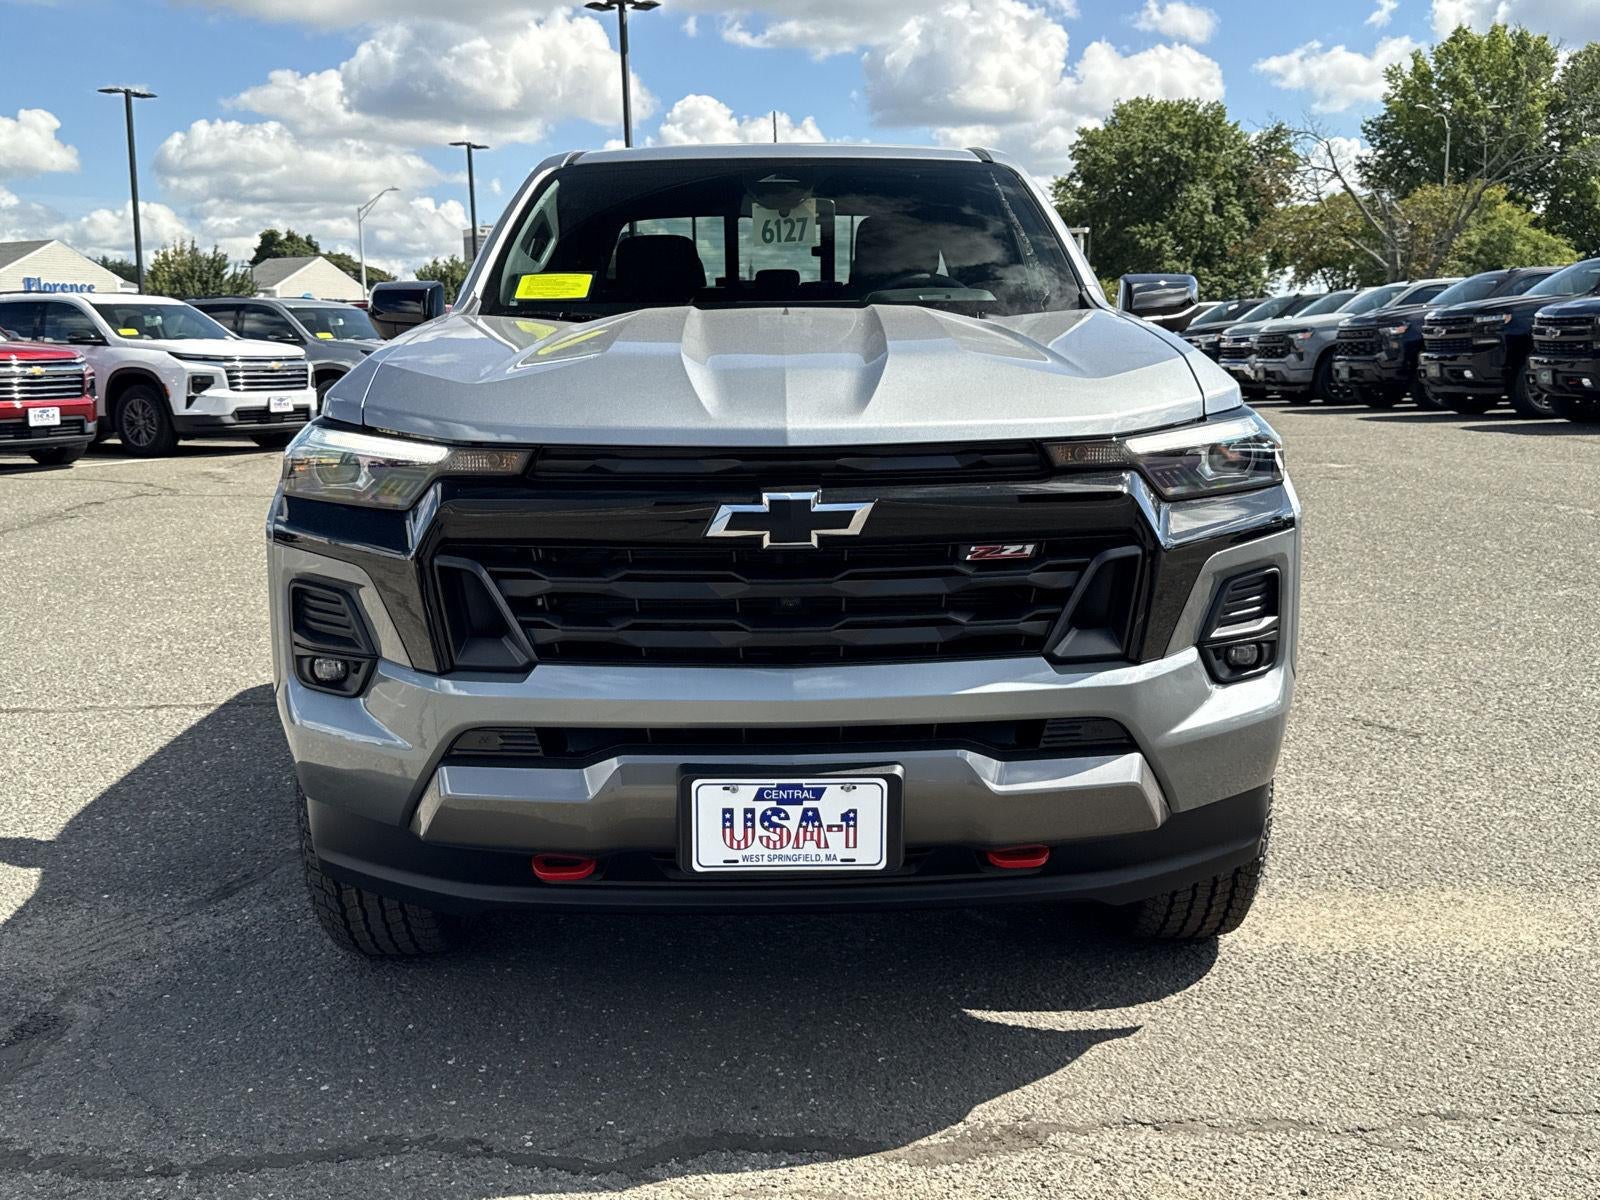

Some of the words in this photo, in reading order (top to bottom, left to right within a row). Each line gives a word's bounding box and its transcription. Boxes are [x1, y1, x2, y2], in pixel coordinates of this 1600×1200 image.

[761, 217, 809, 244] 6127
[22, 277, 95, 293] Florence
[763, 789, 816, 799] CENTRAL
[721, 806, 858, 850] USA-1
[741, 854, 765, 863] WEST
[767, 854, 823, 863] SPRINGFIELD,
[825, 854, 838, 862] MA
